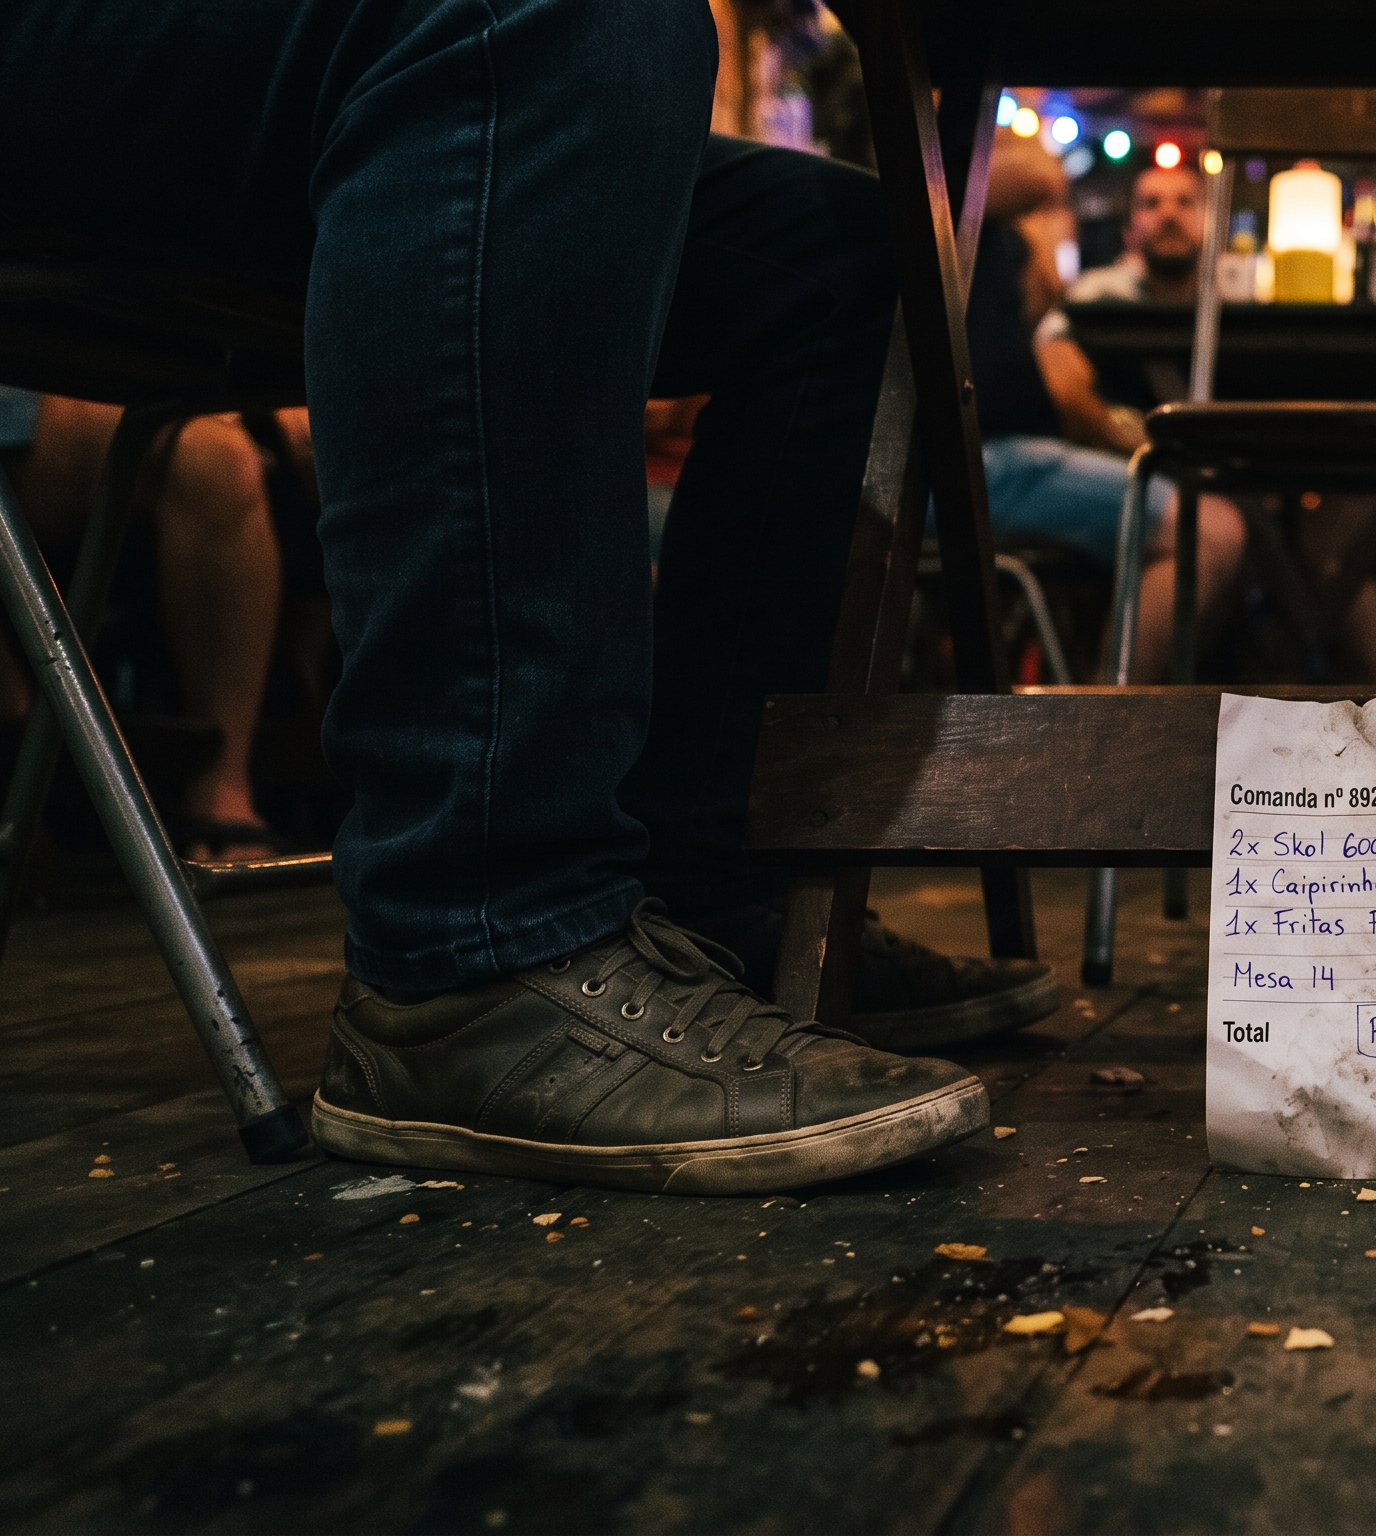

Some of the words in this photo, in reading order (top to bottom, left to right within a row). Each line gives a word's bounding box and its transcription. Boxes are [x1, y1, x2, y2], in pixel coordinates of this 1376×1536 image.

[1230, 784, 1317, 808] Comanda
[1230, 829, 1259, 855] 2x
[1274, 831, 1324, 856] Skol
[1226, 868, 1257, 896] 1x
[1226, 909, 1256, 936] 1x
[1273, 908, 1344, 936] Fritas
[1234, 962, 1293, 989] Mesa
[1312, 966, 1333, 990] 14
[1223, 1022, 1269, 1042] Total
